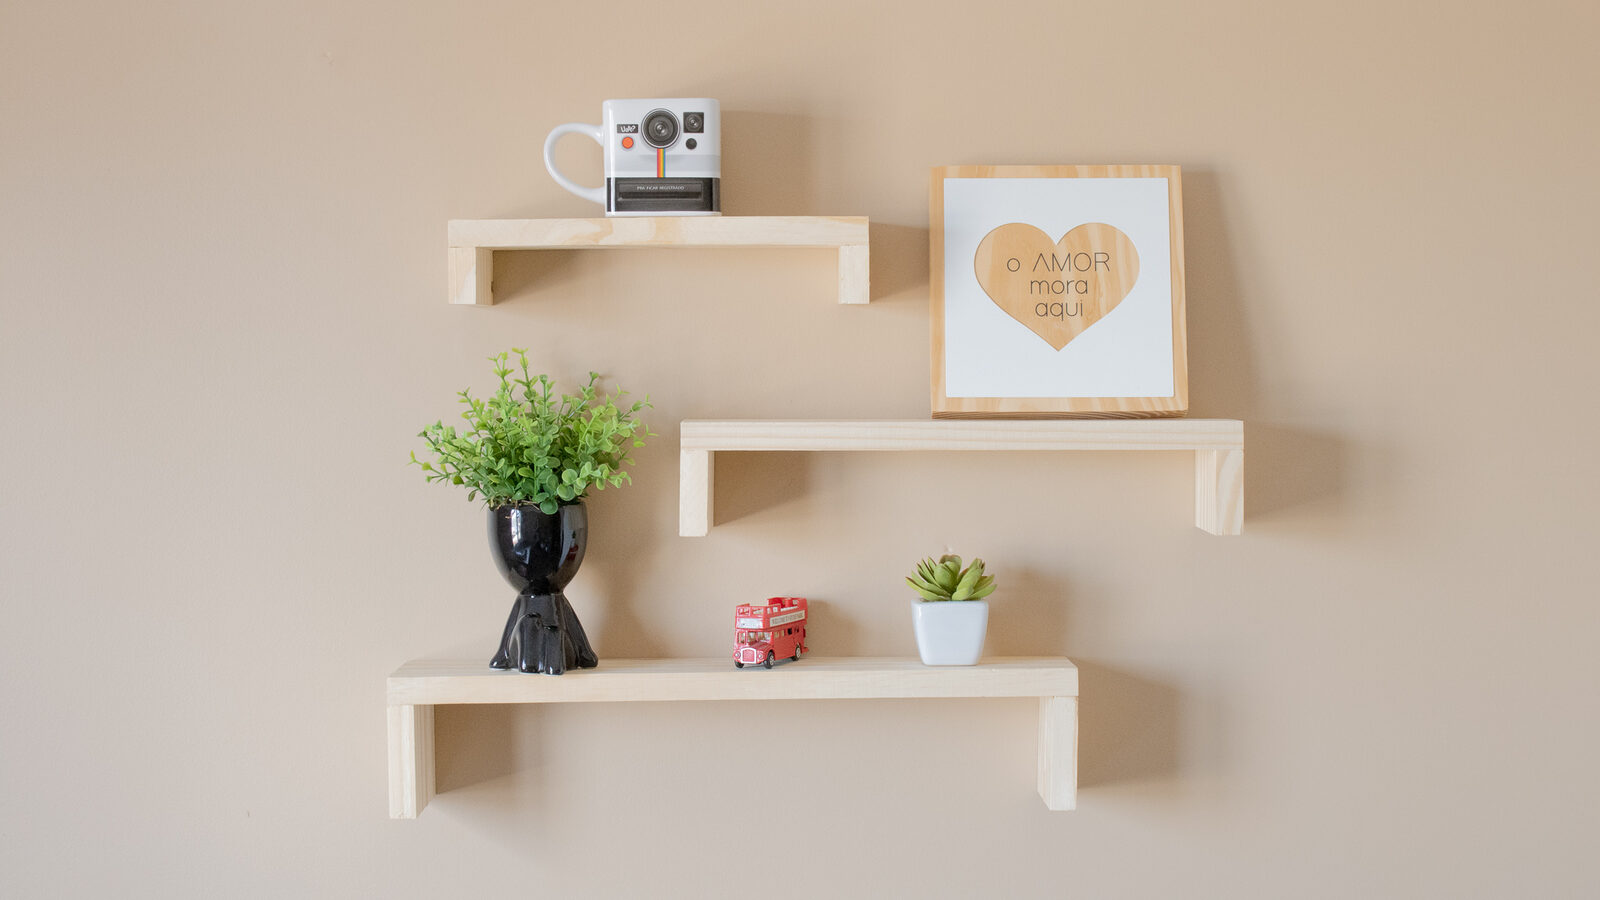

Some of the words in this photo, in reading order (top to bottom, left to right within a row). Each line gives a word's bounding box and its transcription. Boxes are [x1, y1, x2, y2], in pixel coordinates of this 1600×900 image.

[1032, 252, 1110, 272] AMOR
[1030, 279, 1088, 295] mora
[1035, 300, 1084, 322] aqui
